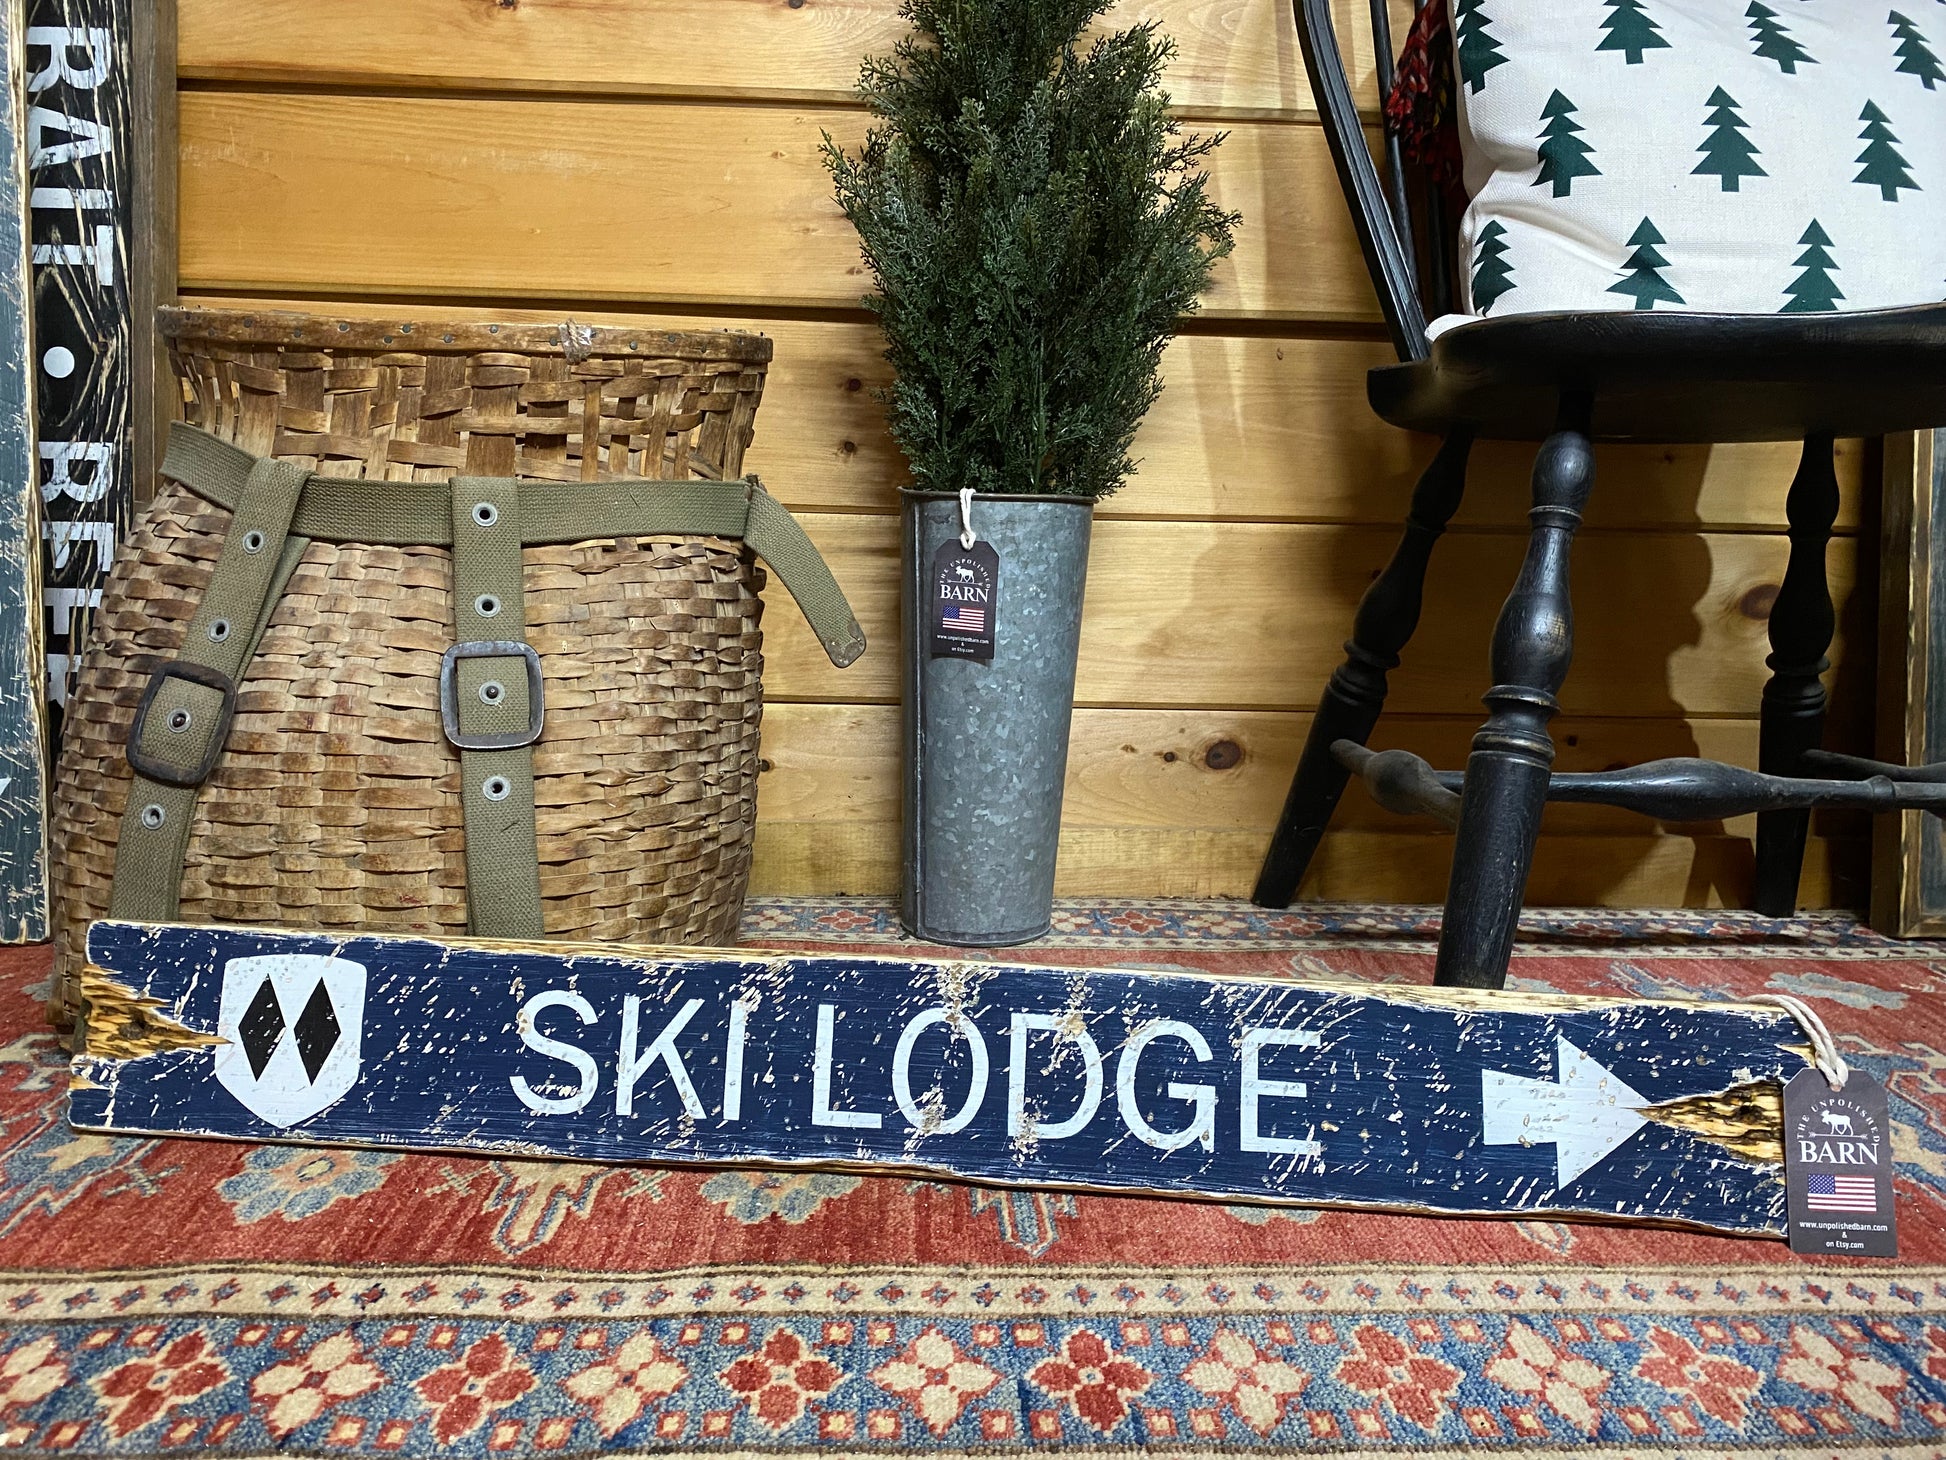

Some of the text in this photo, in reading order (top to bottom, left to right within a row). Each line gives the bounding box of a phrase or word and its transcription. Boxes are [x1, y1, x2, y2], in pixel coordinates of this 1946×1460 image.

[27, 26, 114, 287] BAIT
[939, 558, 991, 589] THE UNPOLISHED
[939, 584, 990, 603] BARN
[509, 989, 1322, 1156] SKI LODGE
[1796, 1098, 1881, 1143] THE UNPOLISHED
[1798, 1140, 1880, 1166] BARN
[1799, 1221, 1888, 1232] www.unpolishedbarn.com
[1841, 1231, 1848, 1239] &
[1836, 1241, 1865, 1250] Etsy.com
